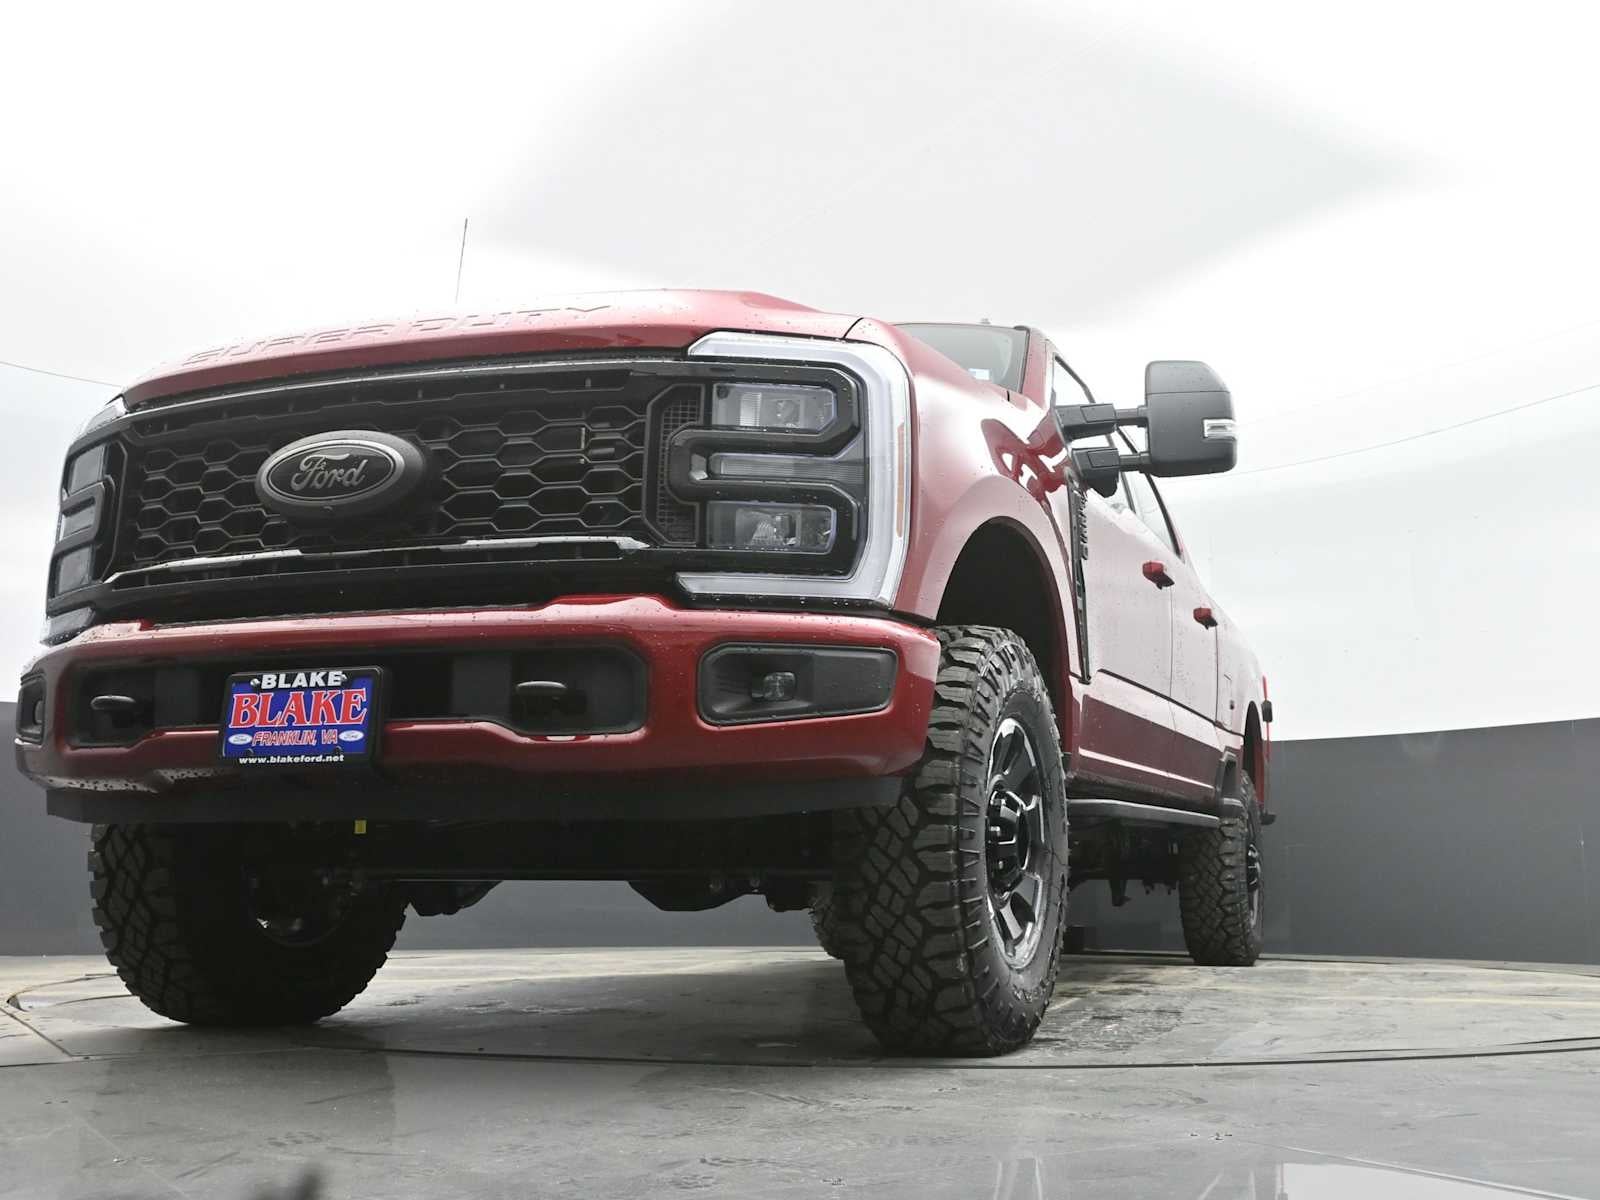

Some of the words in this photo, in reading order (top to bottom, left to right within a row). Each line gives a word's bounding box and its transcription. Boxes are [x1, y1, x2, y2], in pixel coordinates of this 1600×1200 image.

[290, 453, 368, 491] Ford
[261, 671, 343, 690] BLAKE
[229, 688, 368, 728] BLAKE
[252, 730, 317, 746] FRANKLIN,
[321, 729, 338, 745] VA
[239, 755, 345, 764] www.blakeford.net
